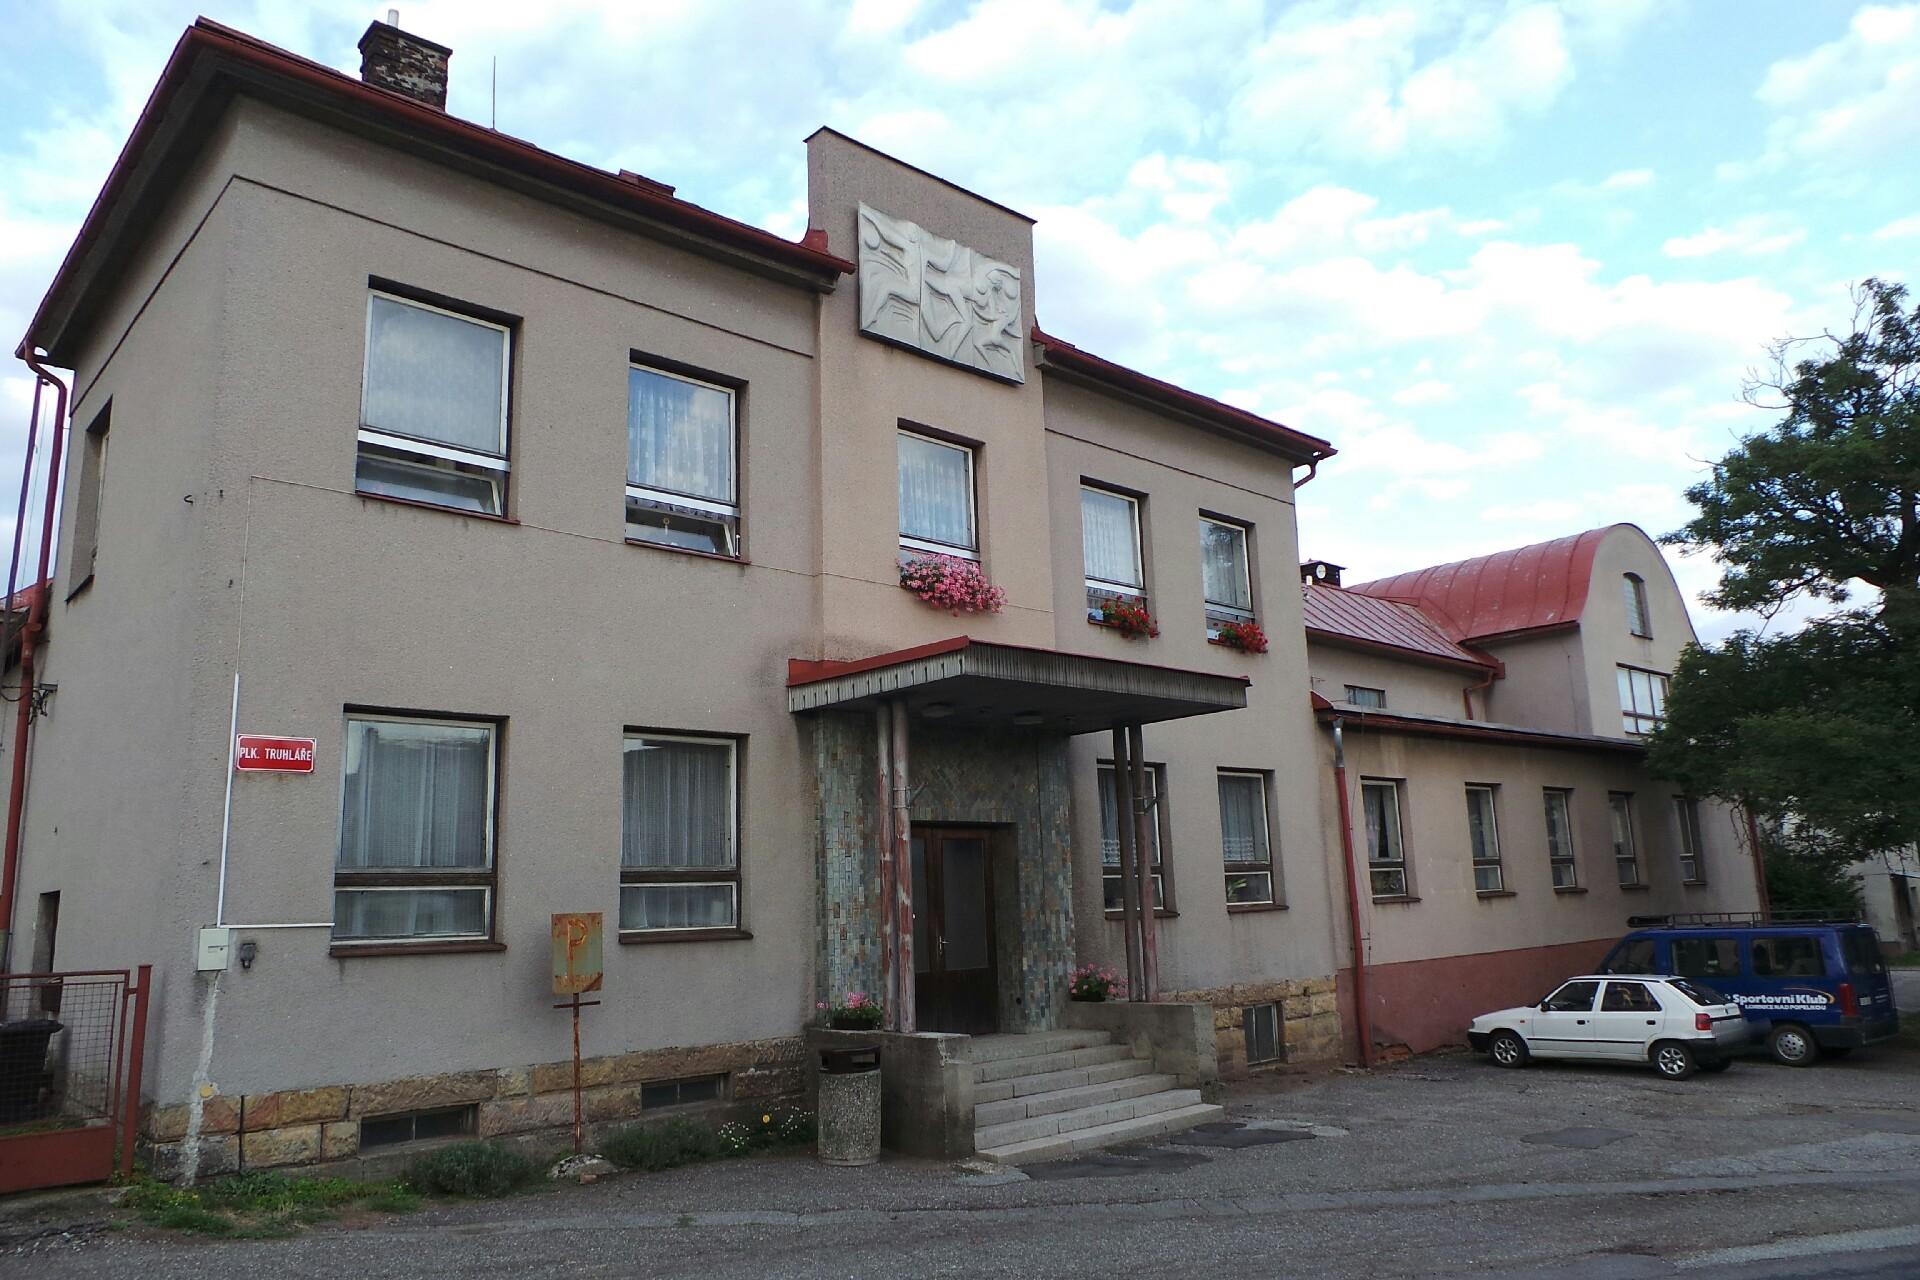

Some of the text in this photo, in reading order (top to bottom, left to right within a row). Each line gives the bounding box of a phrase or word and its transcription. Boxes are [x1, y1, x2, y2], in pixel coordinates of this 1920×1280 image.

[239, 747, 312, 761] PLK. TRUHLÁŘE
[1795, 994, 1828, 1004] Klub
